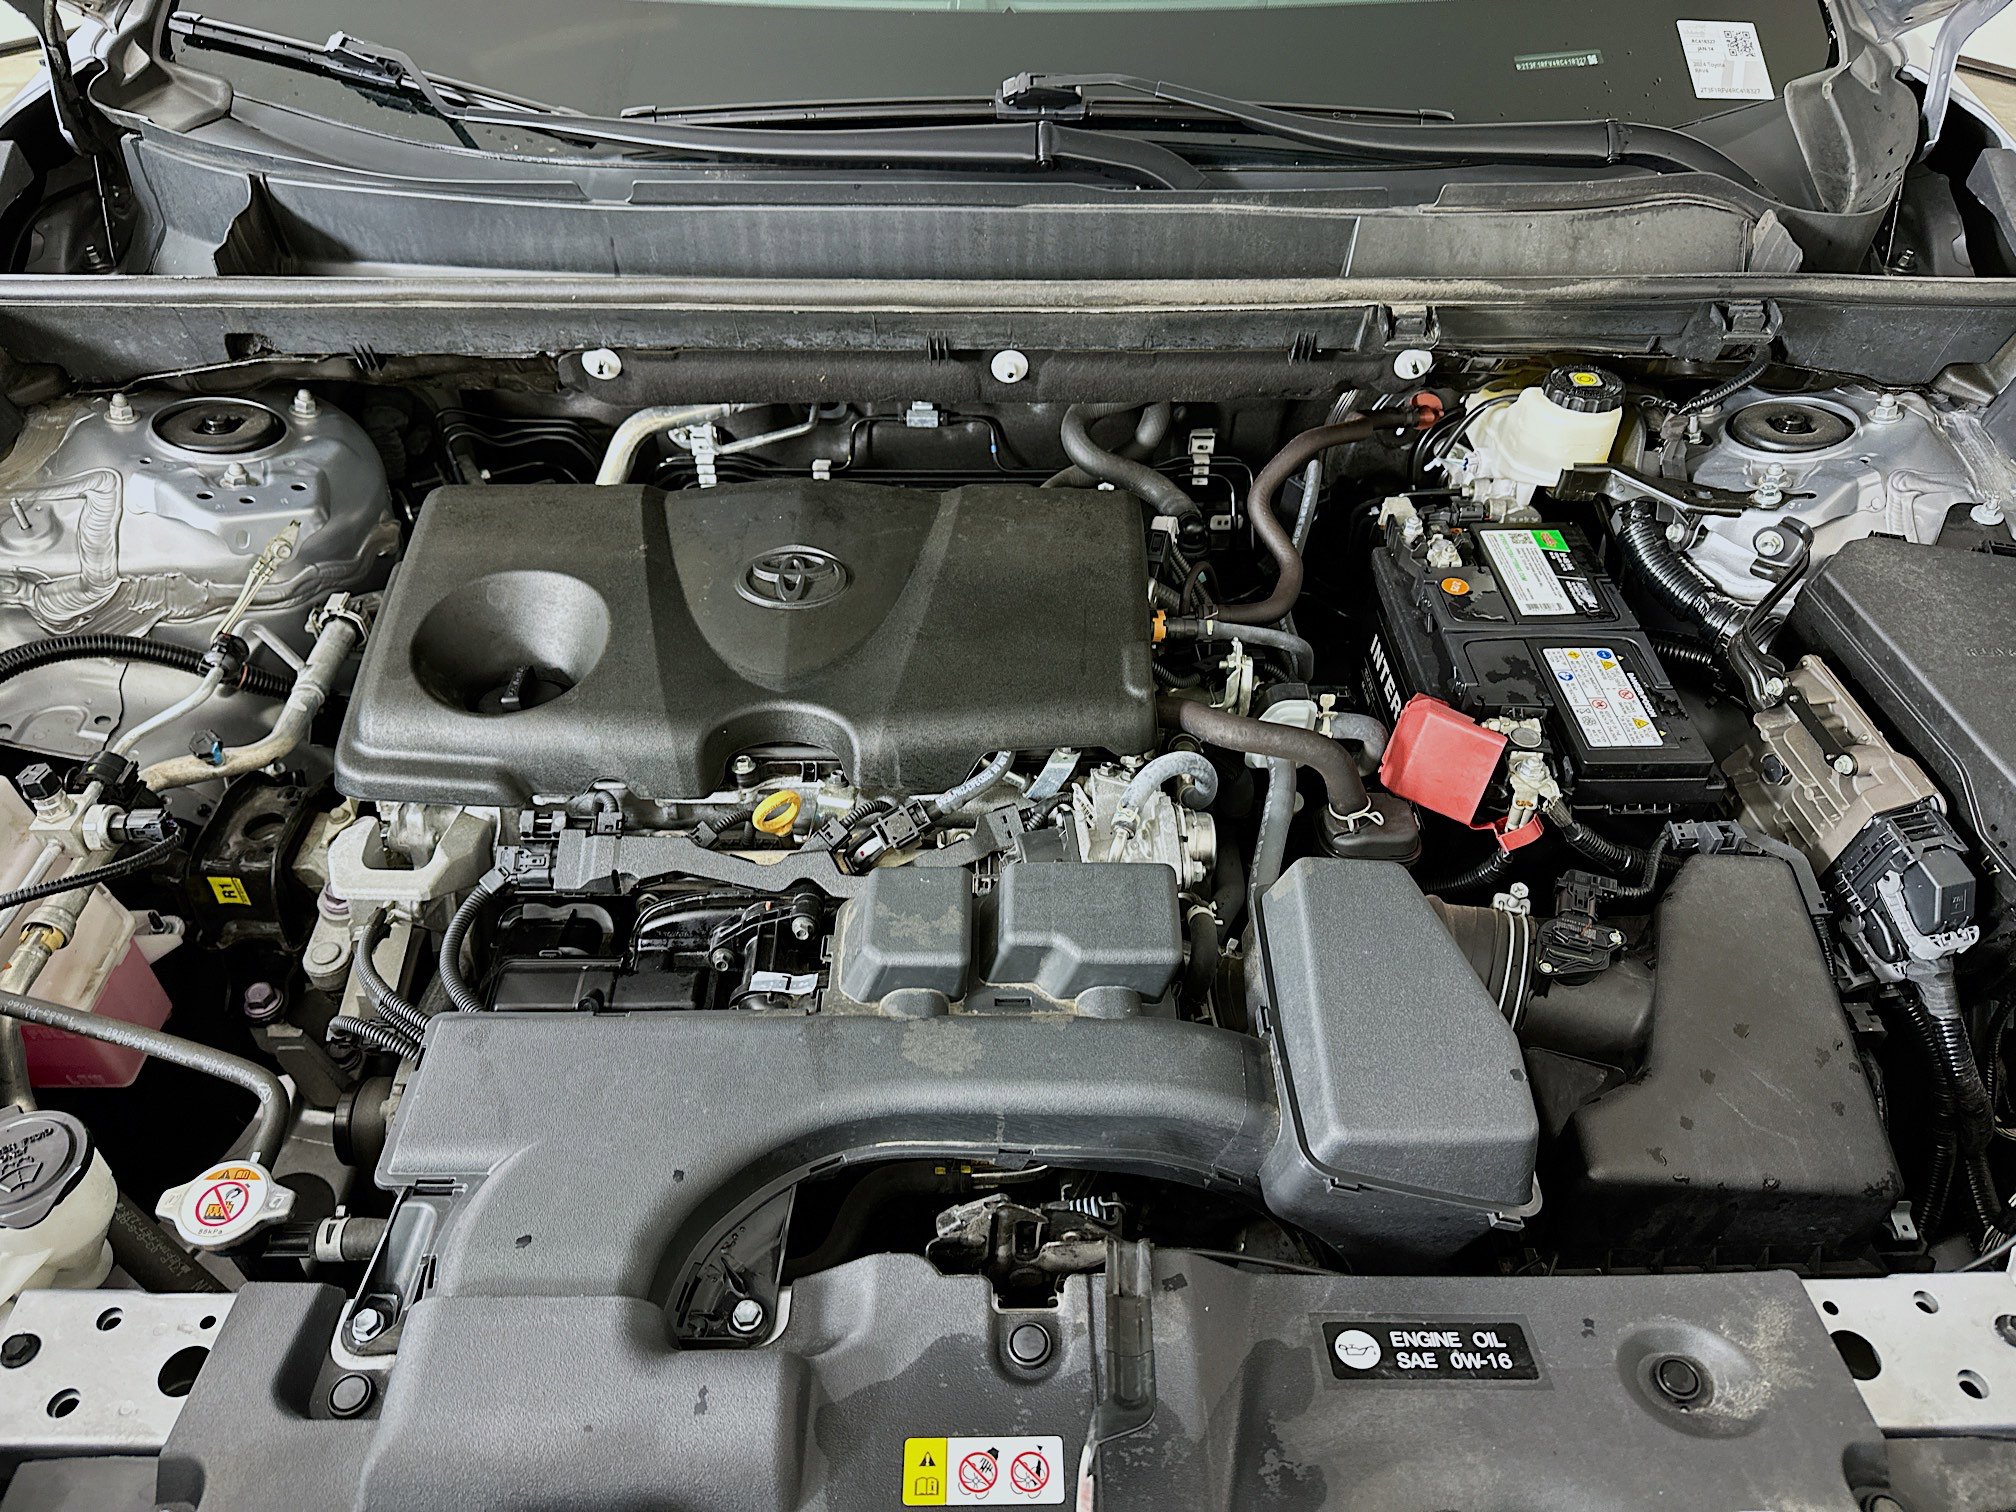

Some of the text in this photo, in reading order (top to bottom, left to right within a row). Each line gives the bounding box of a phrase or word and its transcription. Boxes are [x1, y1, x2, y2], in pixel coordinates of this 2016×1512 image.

[1389, 1331, 1507, 1348] ENGINE OIL
[1396, 1352, 1513, 1369] SAE 0W-16
